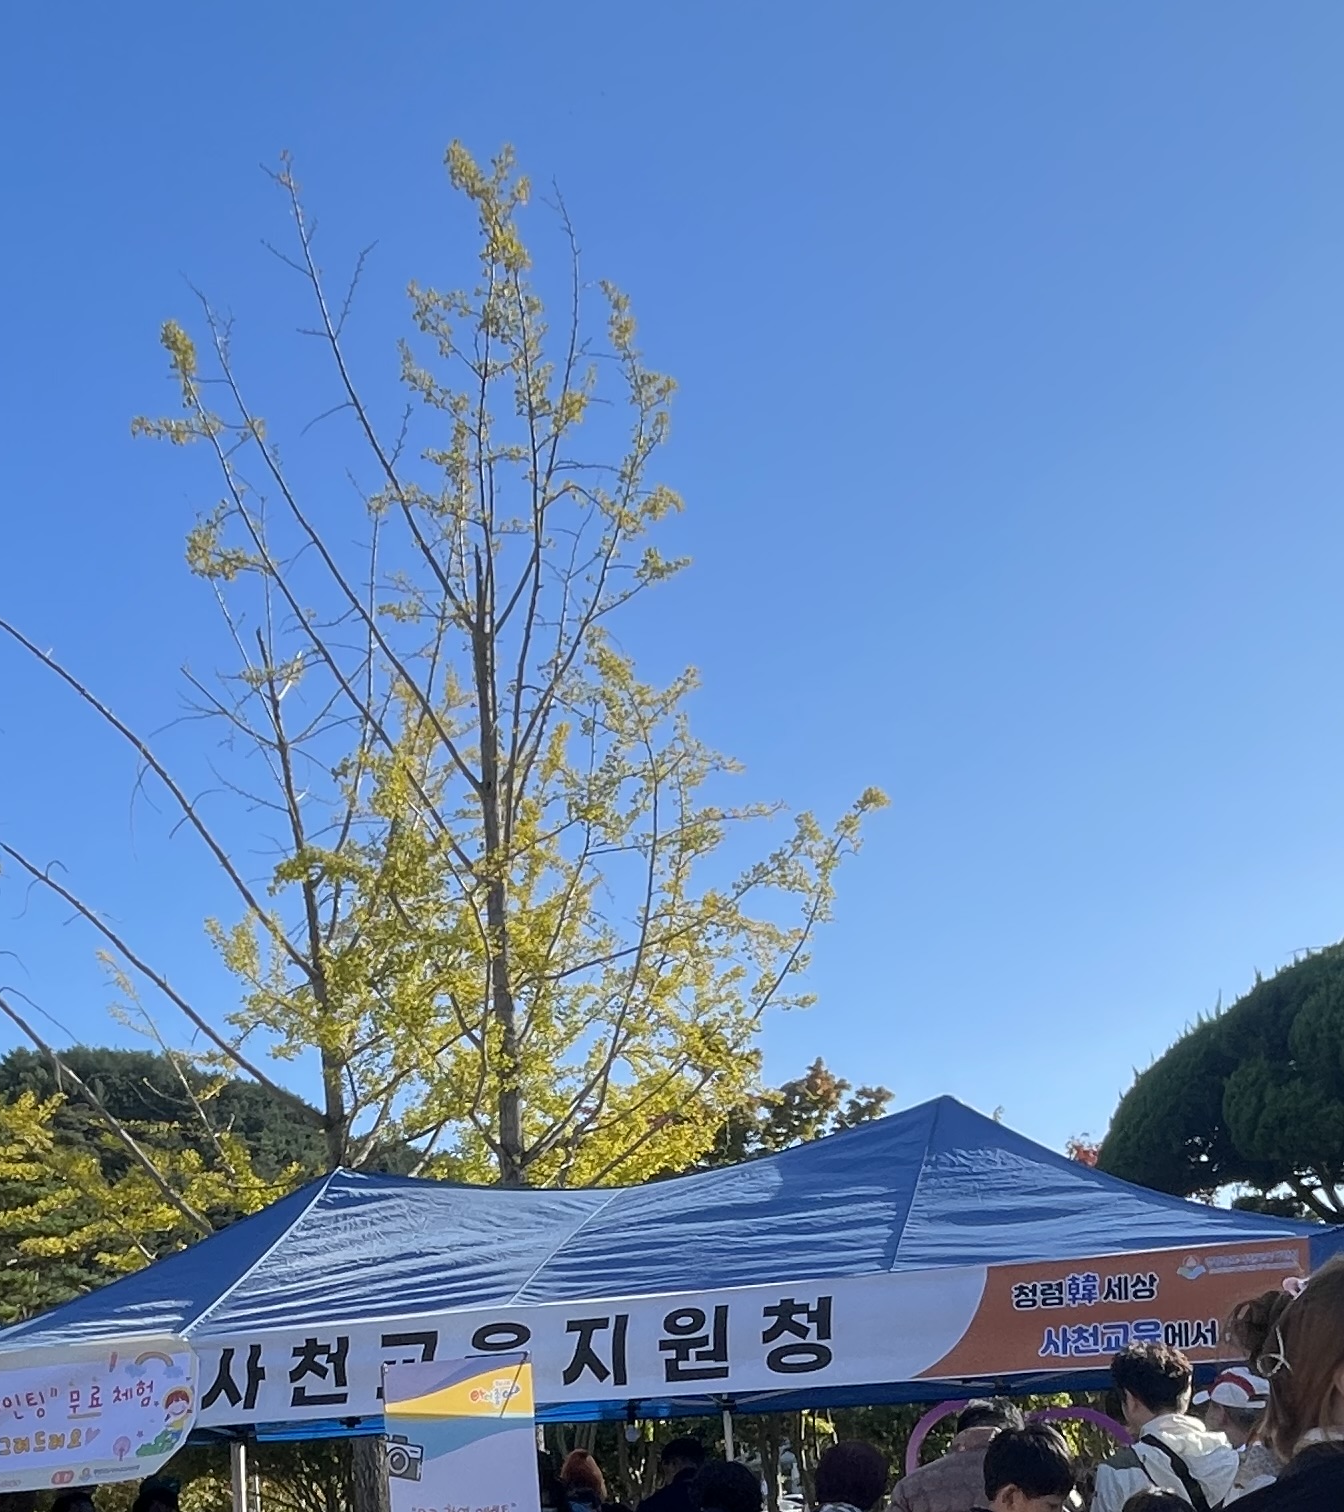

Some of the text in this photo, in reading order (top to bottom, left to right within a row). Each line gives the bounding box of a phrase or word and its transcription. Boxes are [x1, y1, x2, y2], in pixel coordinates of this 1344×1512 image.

[1102, 1273, 1158, 1303] 세상
[68, 1386, 103, 1414] 무료
[112, 1380, 154, 1408] 체험
